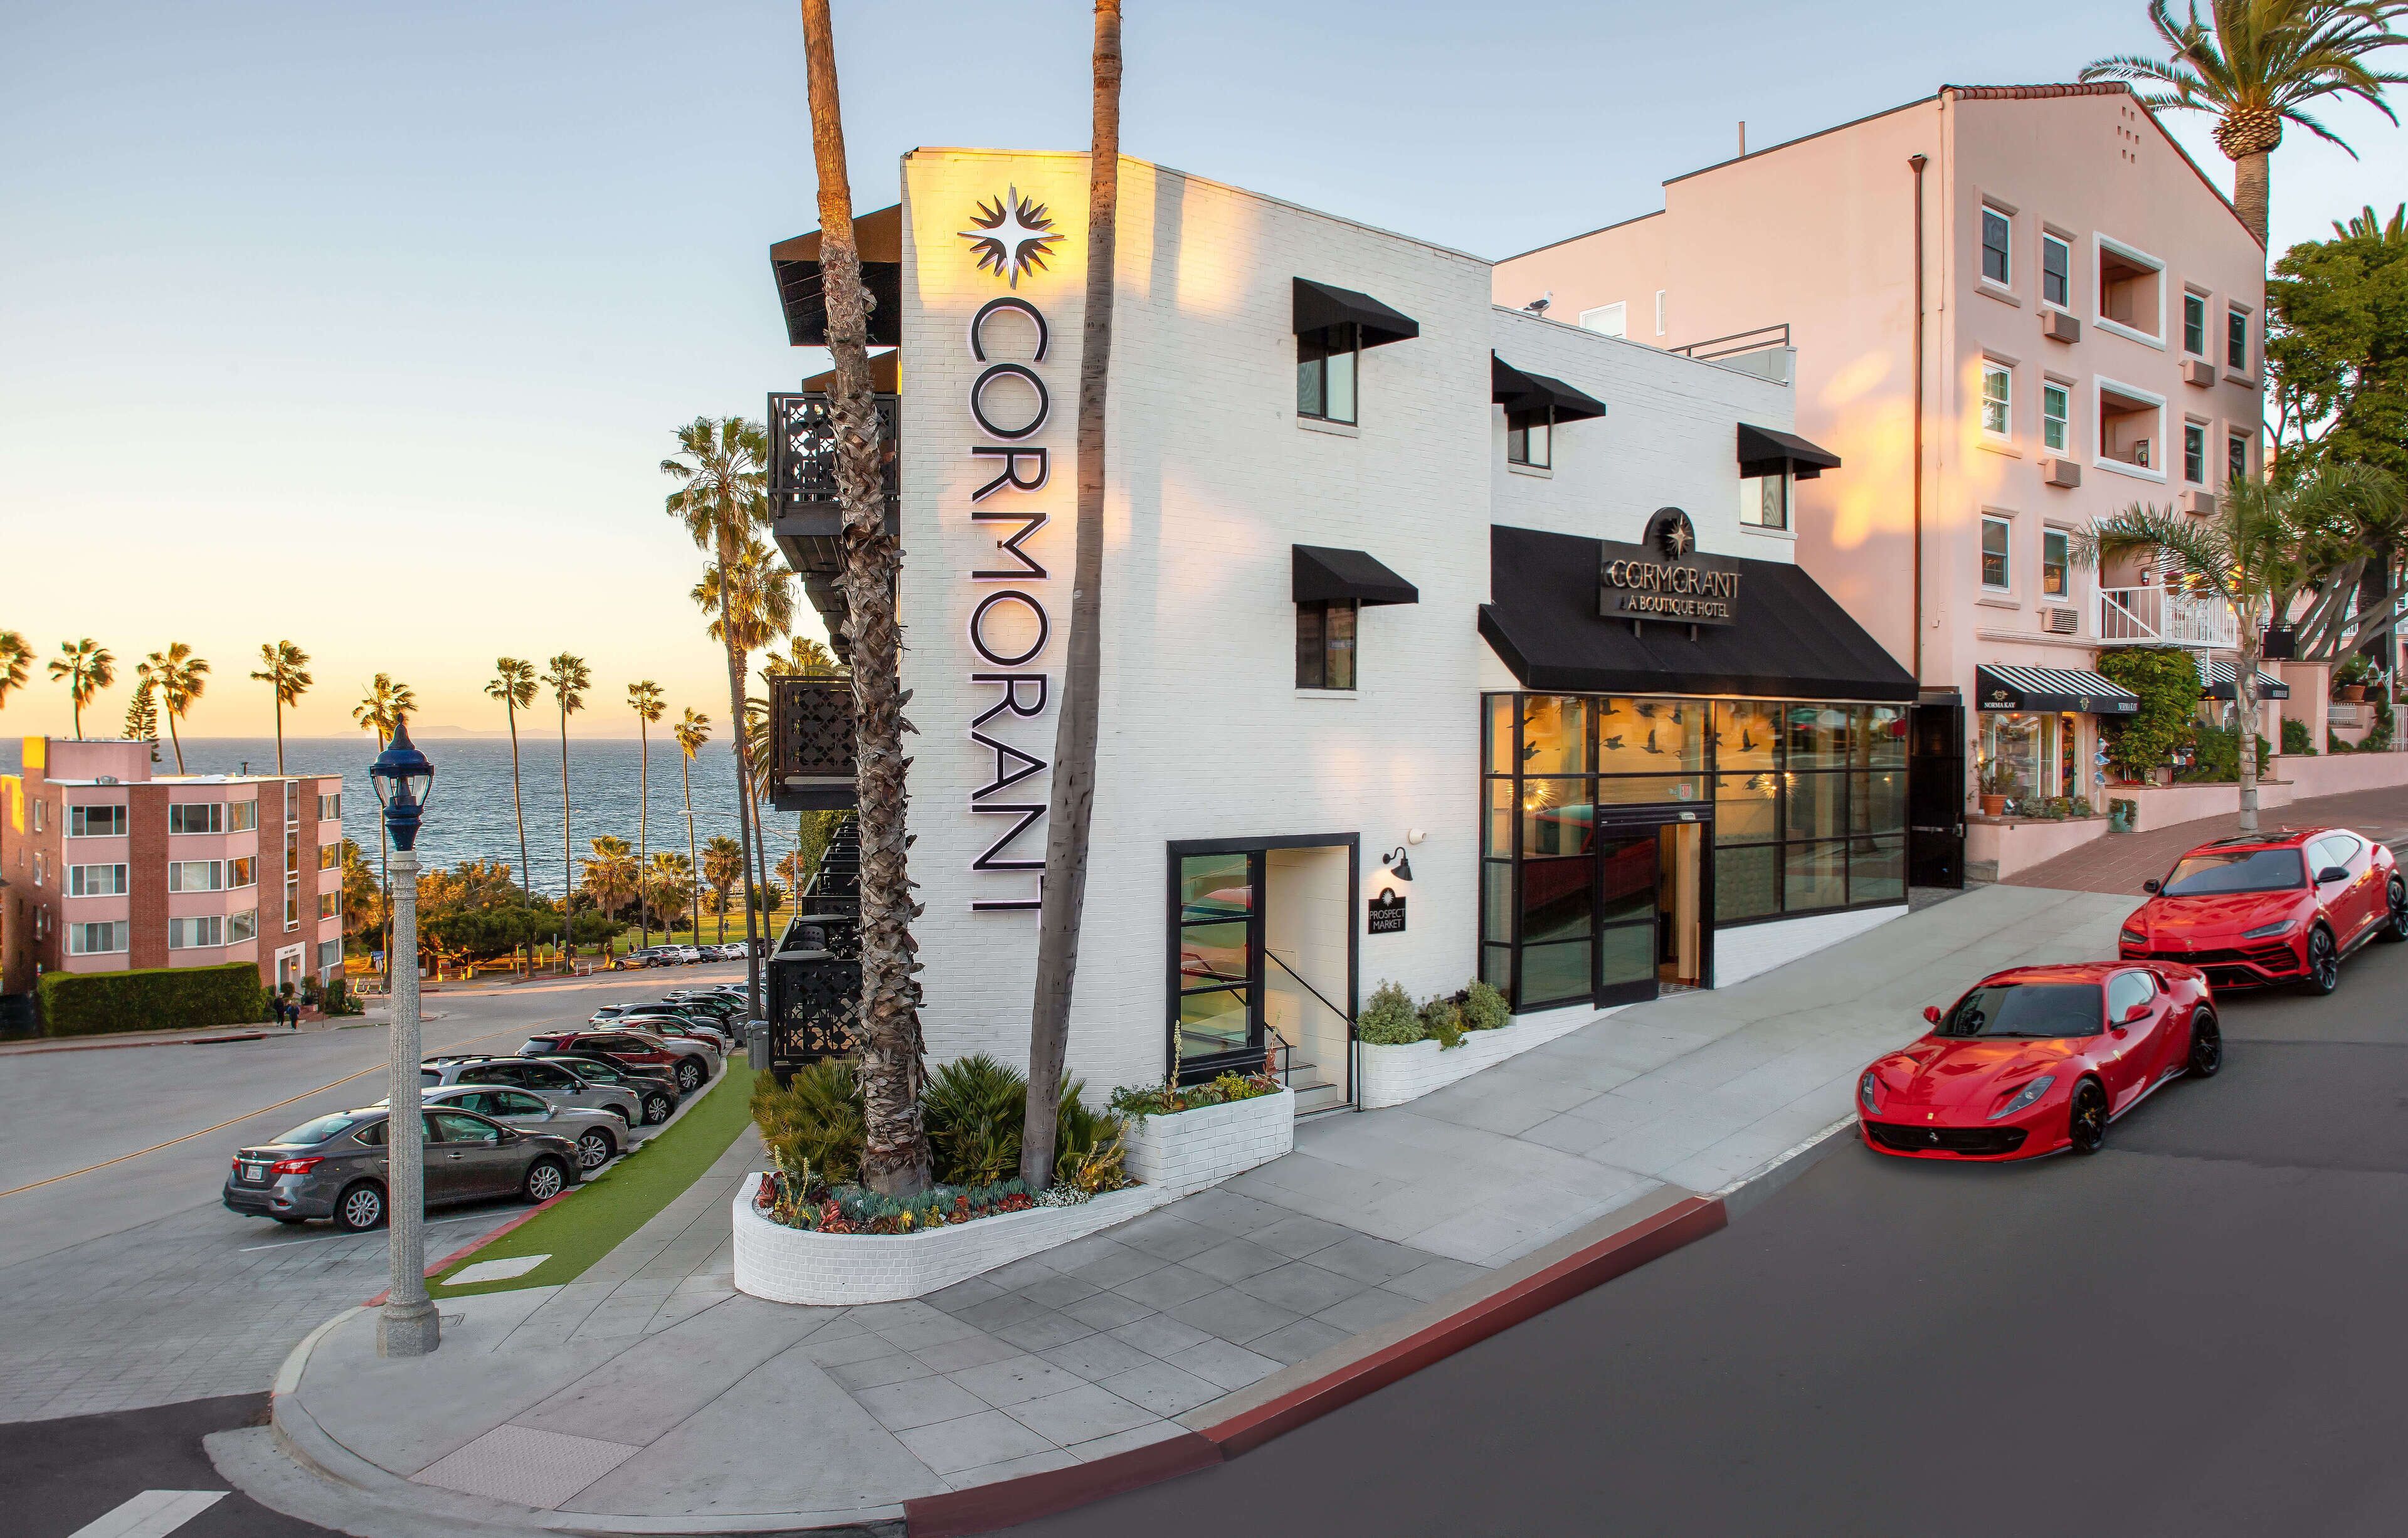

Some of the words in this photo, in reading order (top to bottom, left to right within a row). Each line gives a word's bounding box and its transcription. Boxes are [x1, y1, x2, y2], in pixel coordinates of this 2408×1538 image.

[1610, 559, 1742, 598] CORMORANT
[969, 297, 1050, 922] CORMORANT
[1628, 595, 1637, 611] A
[1640, 596, 1694, 616] BOUTIQUE
[1697, 602, 1729, 618] HOTEL
[1369, 908, 1405, 920] PROSPECT
[1373, 919, 1402, 930] MARKET
